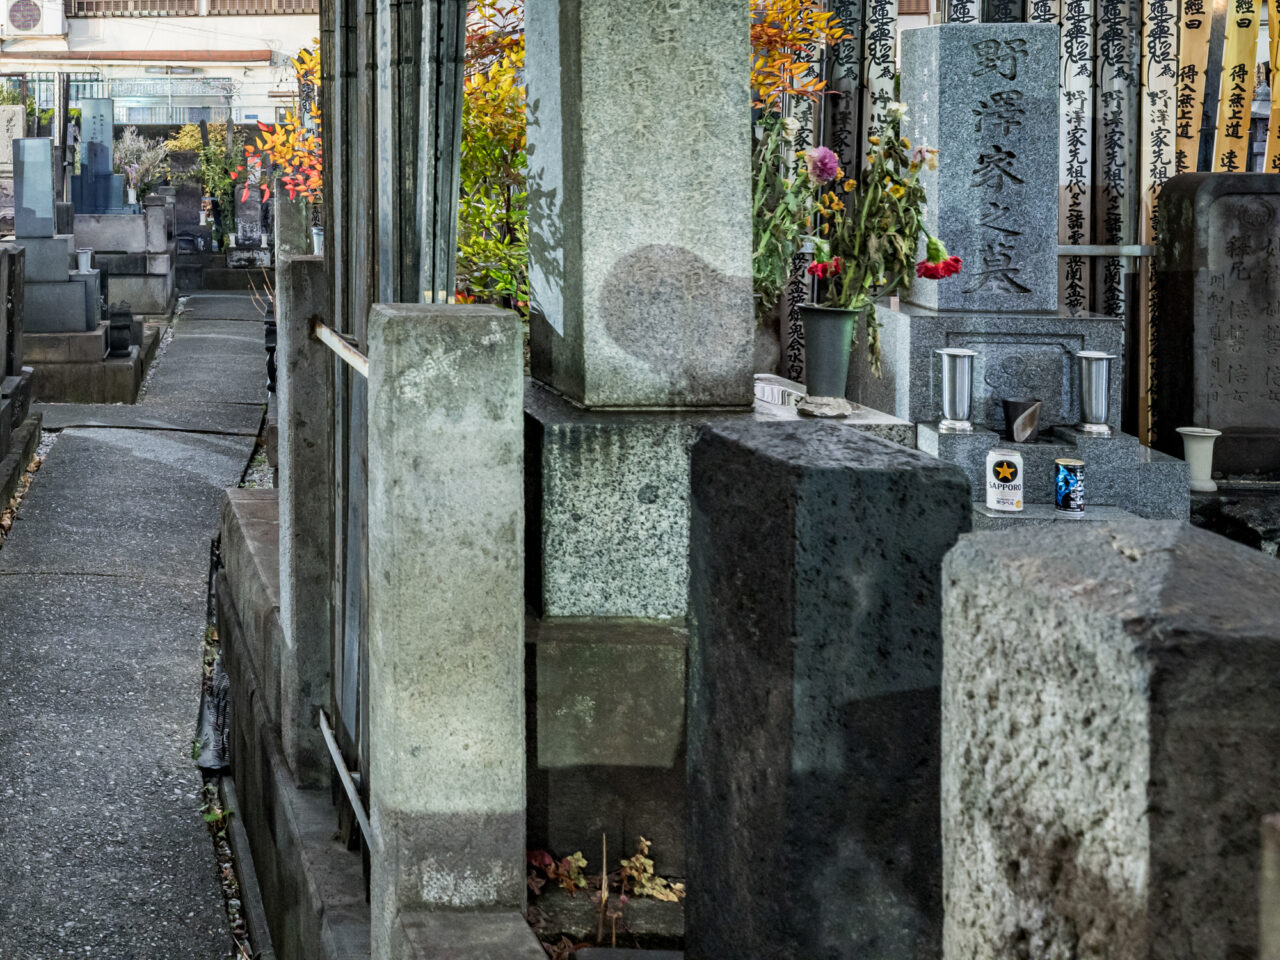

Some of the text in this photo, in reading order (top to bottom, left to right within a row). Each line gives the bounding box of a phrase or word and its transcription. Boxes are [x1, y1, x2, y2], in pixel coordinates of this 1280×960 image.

[1224, 63, 1250, 140] 得入無上道
[989, 481, 1022, 492] SAPPORO
